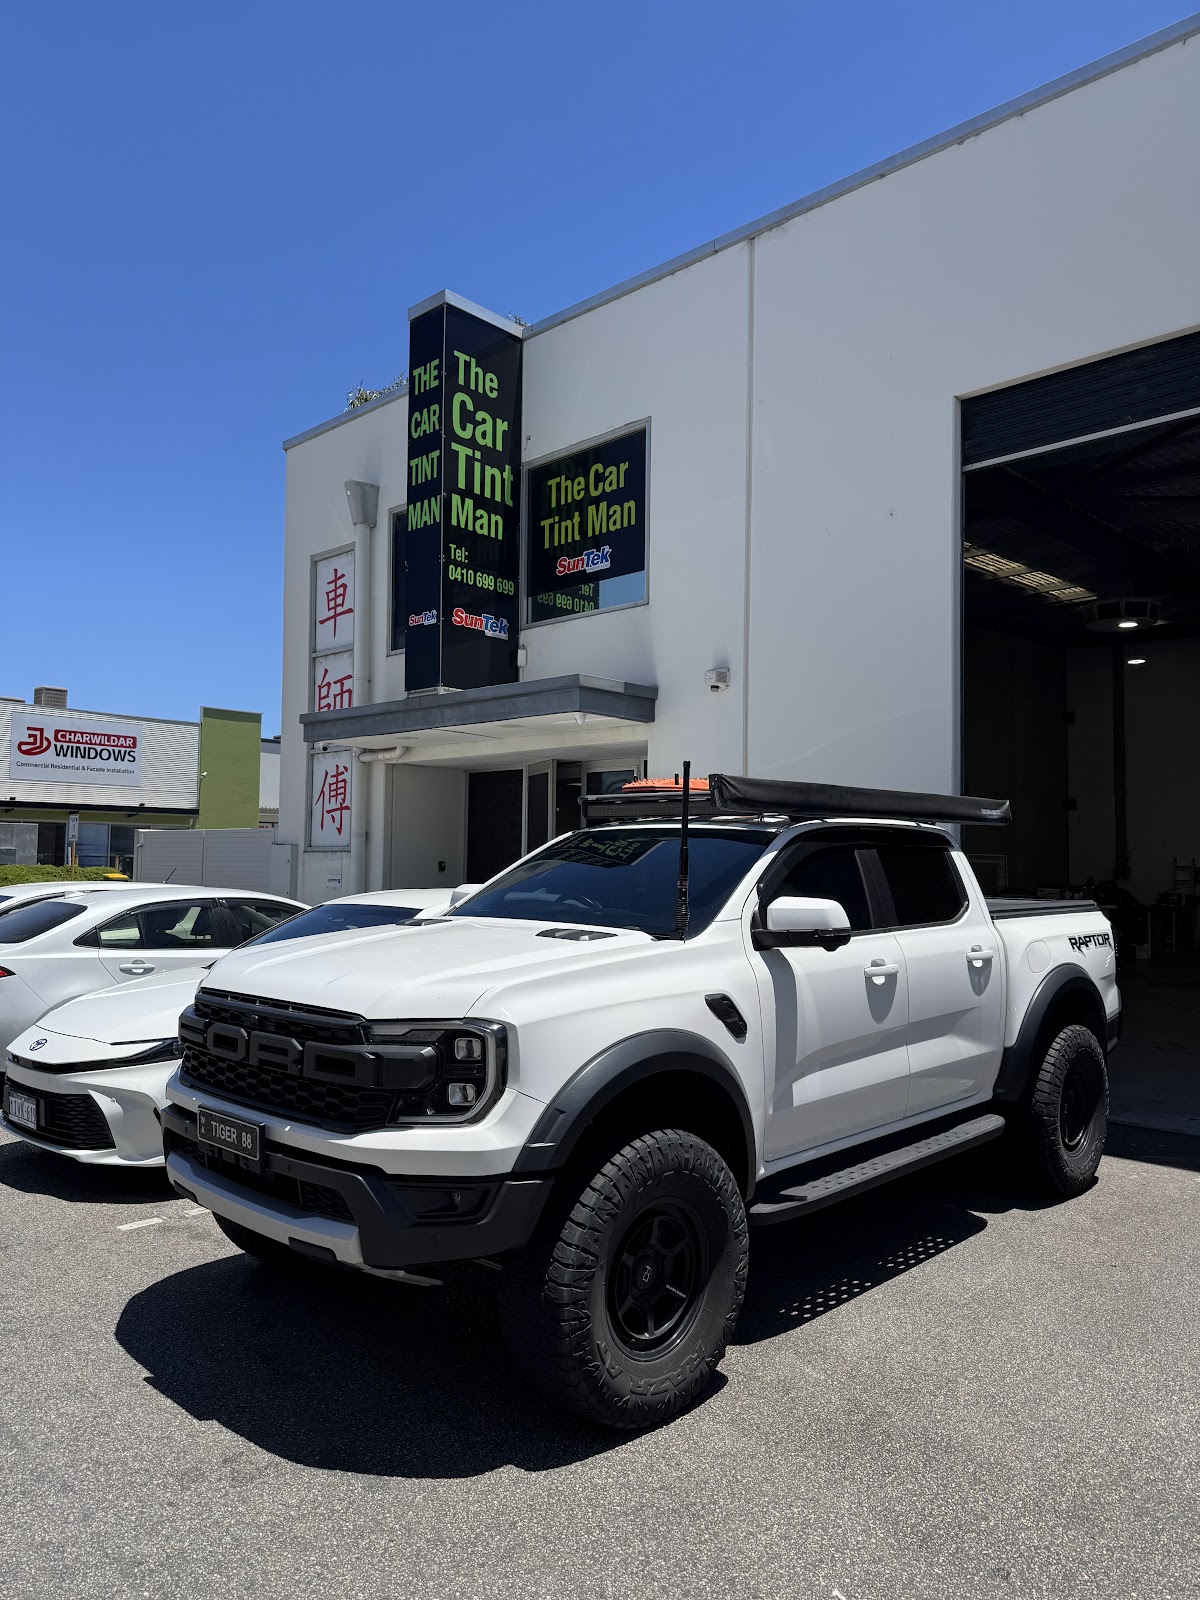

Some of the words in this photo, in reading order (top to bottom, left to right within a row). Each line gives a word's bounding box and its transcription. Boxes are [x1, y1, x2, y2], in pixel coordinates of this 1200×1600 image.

[412, 358, 440, 396] THE
[454, 350, 499, 399] The
[410, 403, 440, 439] CAR
[452, 392, 509, 452] Car
[409, 449, 440, 487] TINT
[451, 441, 514, 507] Tint
[547, 474, 585, 509] The
[589, 460, 629, 497] Car
[408, 494, 441, 532] MAN
[451, 493, 504, 540] Man
[540, 511, 581, 550] Tint
[587, 499, 636, 538] Man
[449, 544, 468, 563] Tel:
[556, 546, 611, 576] SunTek
[448, 564, 474, 585] 0410
[476, 572, 495, 591] 699
[496, 578, 515, 596] 699
[409, 610, 437, 626] SunTek
[452, 607, 509, 635] SunTek
[54, 744, 136, 763] WINDOWS
[57, 731, 134, 747] CHARWILDAR
[16, 761, 50, 769] Commercial
[50, 763, 80, 771] Residential
[86, 765, 105, 773] Facade
[106, 767, 135, 775] Installation
[1068, 933, 1113, 958] RAPTOR
[178, 1004, 382, 1088] FORD
[210, 1121, 237, 1144] TIGER
[241, 1131, 252, 1149] 88
